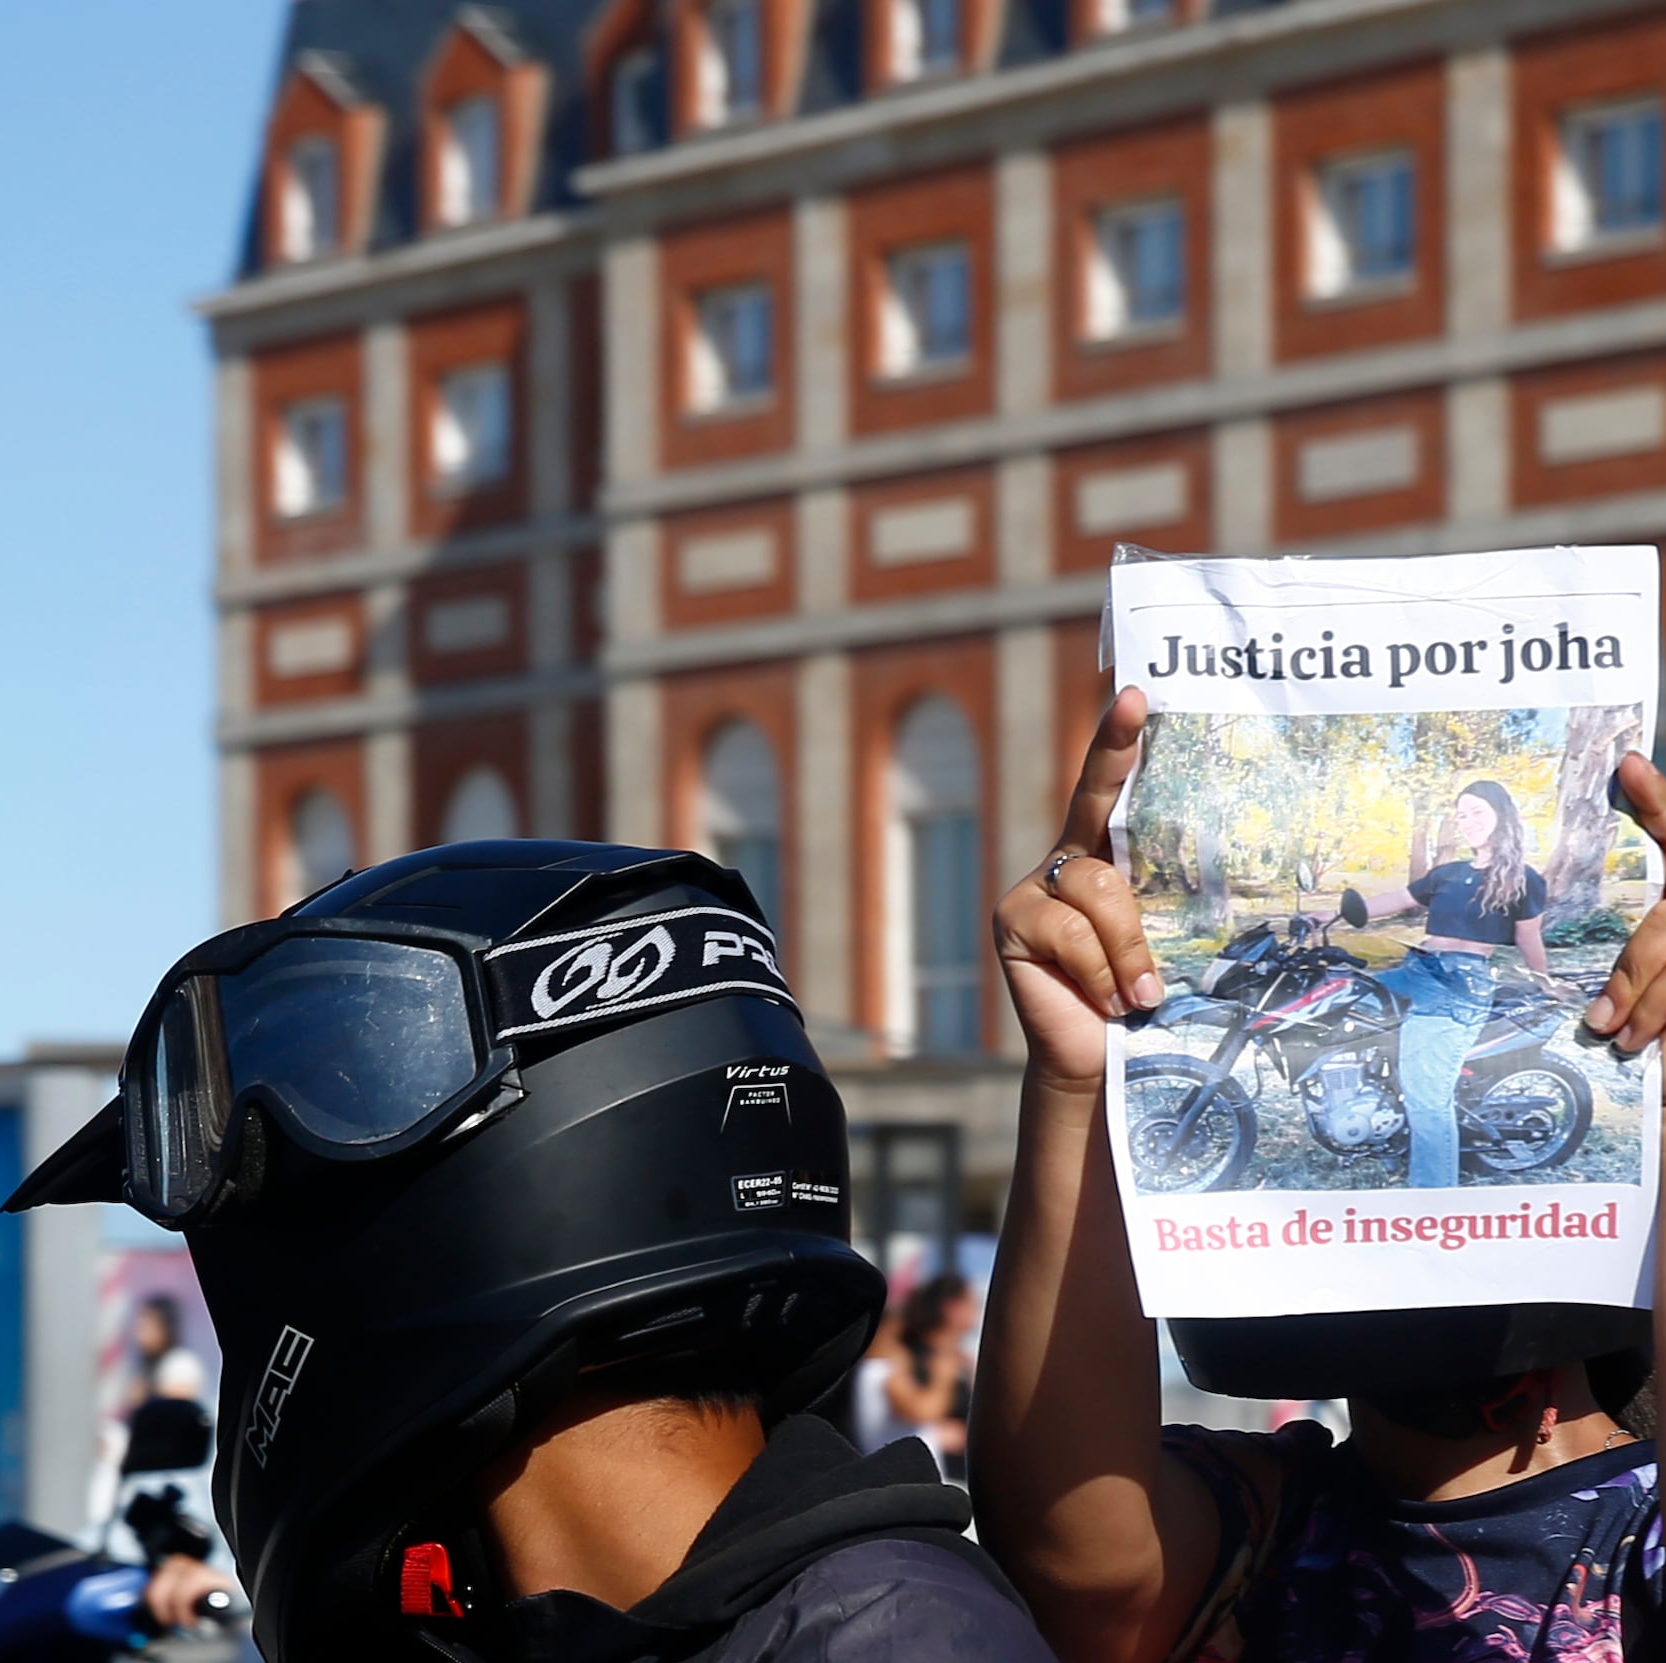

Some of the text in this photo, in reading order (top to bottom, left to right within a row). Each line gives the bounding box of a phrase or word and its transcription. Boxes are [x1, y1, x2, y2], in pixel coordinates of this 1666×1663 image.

[1148, 621, 1624, 689] Justicia por joha
[726, 1065, 790, 1079] Virtus
[1153, 1202, 1620, 1252] Basta de inseguridad
[245, 1324, 315, 1469] MAC
